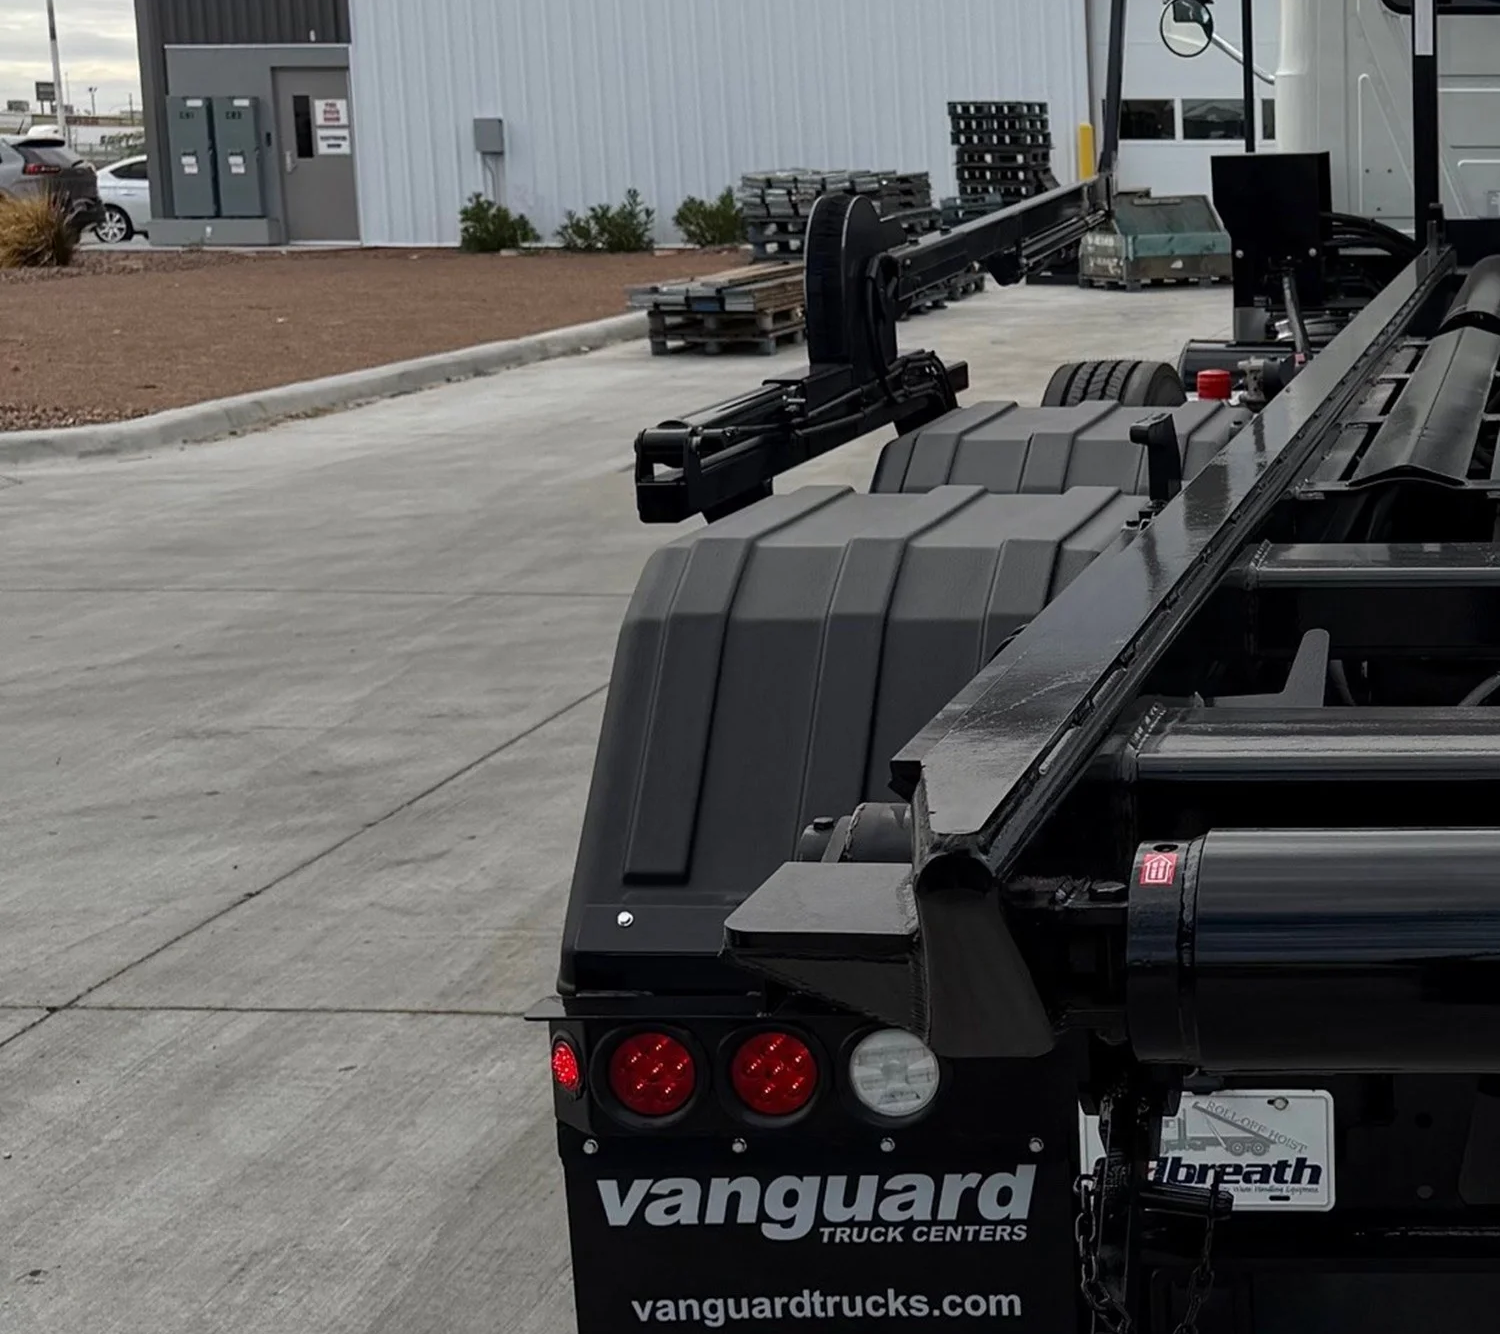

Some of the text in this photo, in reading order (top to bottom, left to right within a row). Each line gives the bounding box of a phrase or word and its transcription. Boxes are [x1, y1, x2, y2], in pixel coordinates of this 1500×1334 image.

[1268, 1129, 1308, 1154] HOIST
[596, 1164, 1037, 1241] vanguard
[819, 1224, 1027, 1243] TRUCK CENTERS
[631, 1288, 1022, 1328] vanguardtrucks.com
